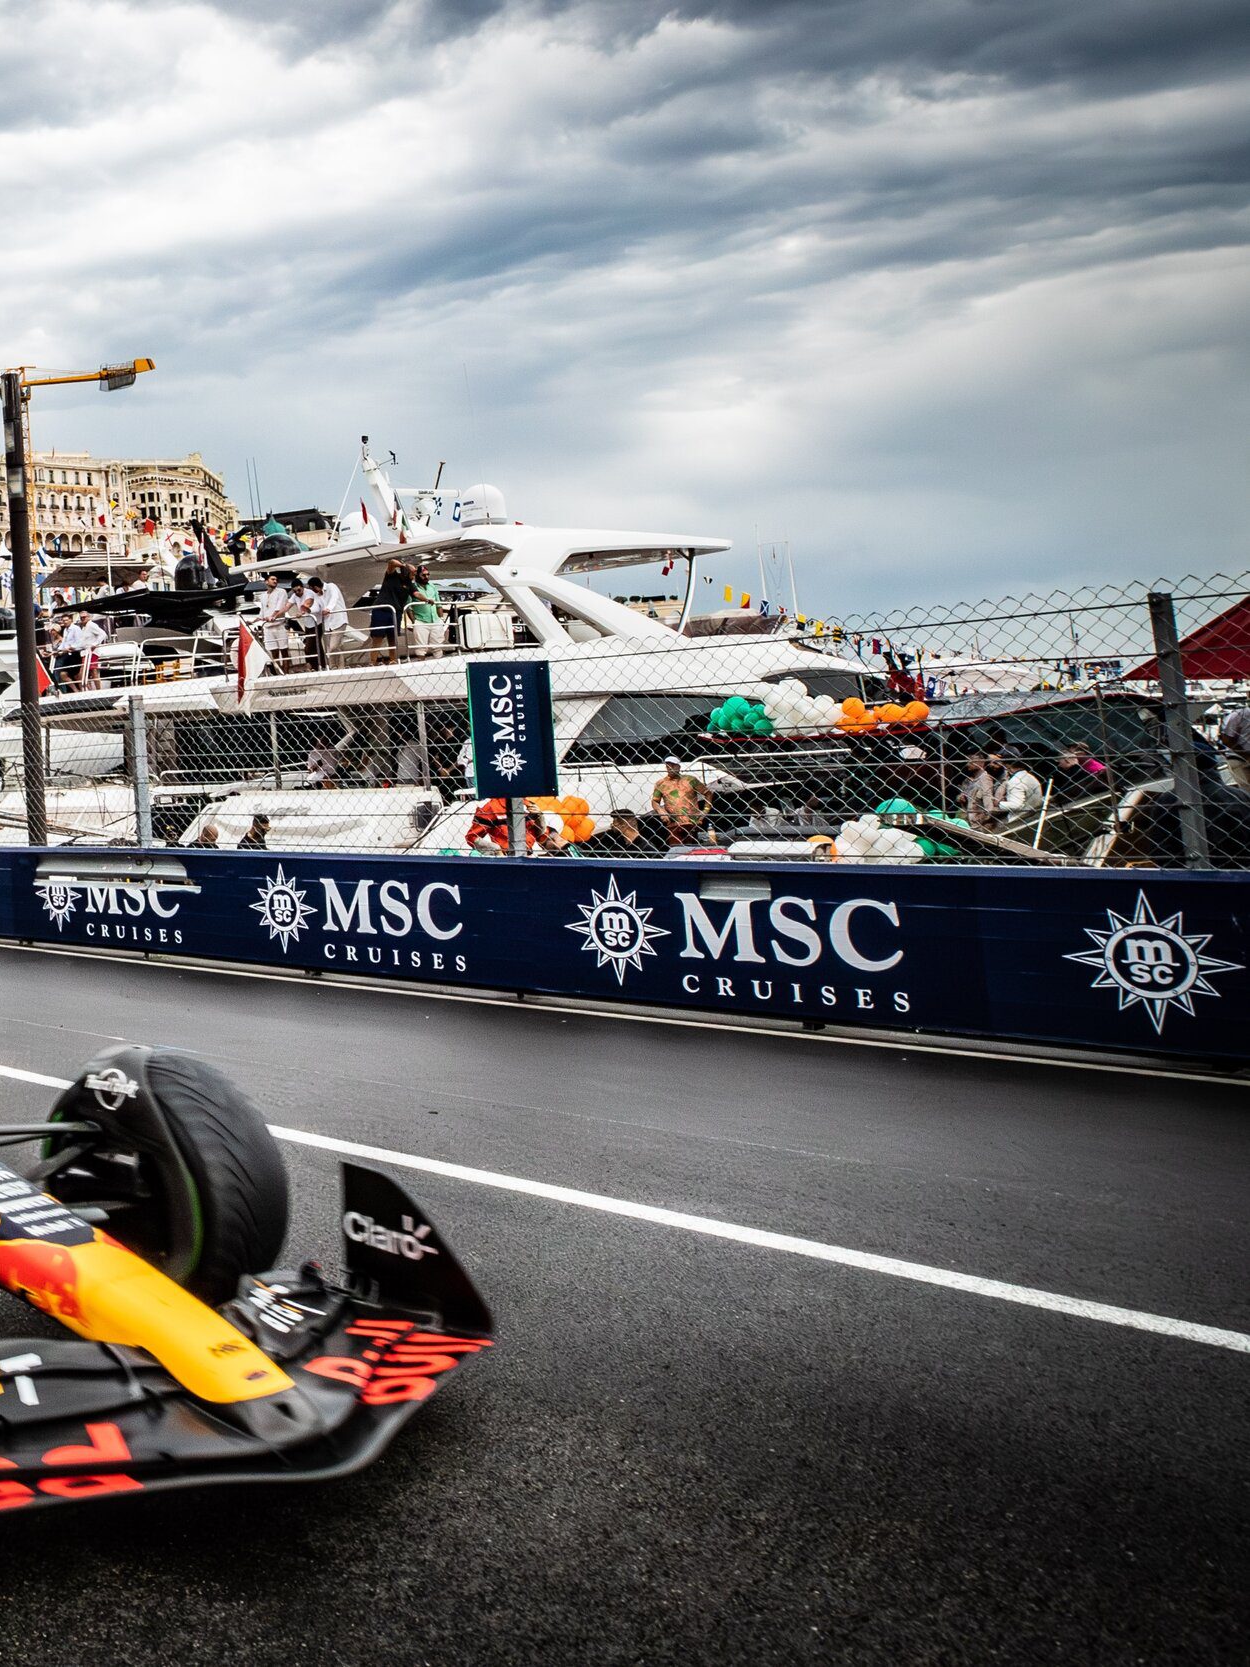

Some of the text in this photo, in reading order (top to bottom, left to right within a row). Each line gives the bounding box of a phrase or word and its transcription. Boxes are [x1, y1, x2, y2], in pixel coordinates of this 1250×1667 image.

[489, 675, 515, 742] MSC
[514, 674, 526, 742] CRUISES
[86, 923, 183, 944] CRUISES
[319, 878, 463, 940] MSC
[674, 892, 903, 971] MSC
[324, 943, 466, 972] CRUISES
[682, 974, 910, 1012] CRUISES
